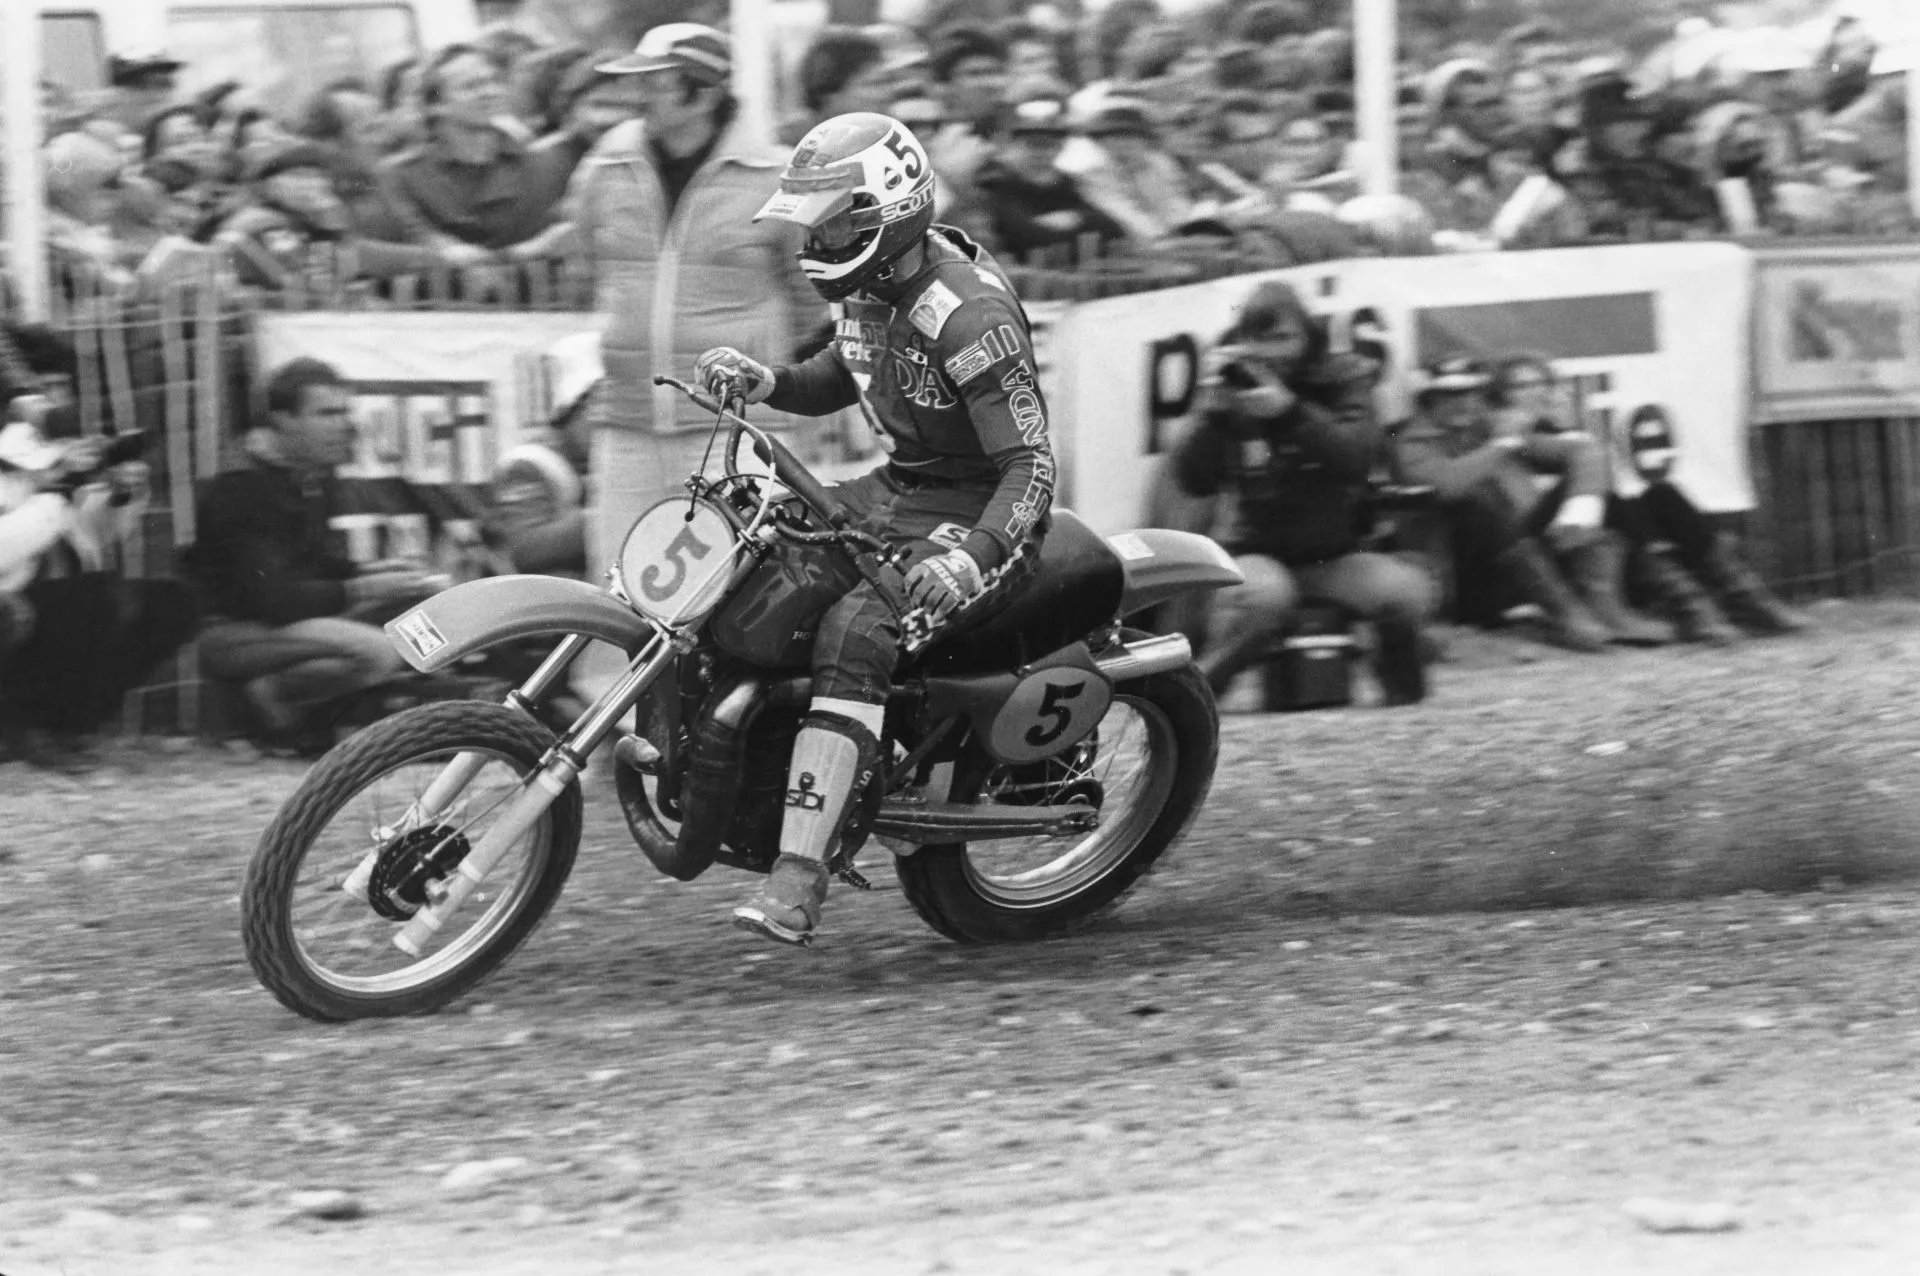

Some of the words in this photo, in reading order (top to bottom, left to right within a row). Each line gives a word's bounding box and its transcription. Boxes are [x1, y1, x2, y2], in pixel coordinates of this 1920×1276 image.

[884, 129, 922, 180] 5
[639, 521, 712, 603] 5
[1024, 680, 1087, 748] 5
